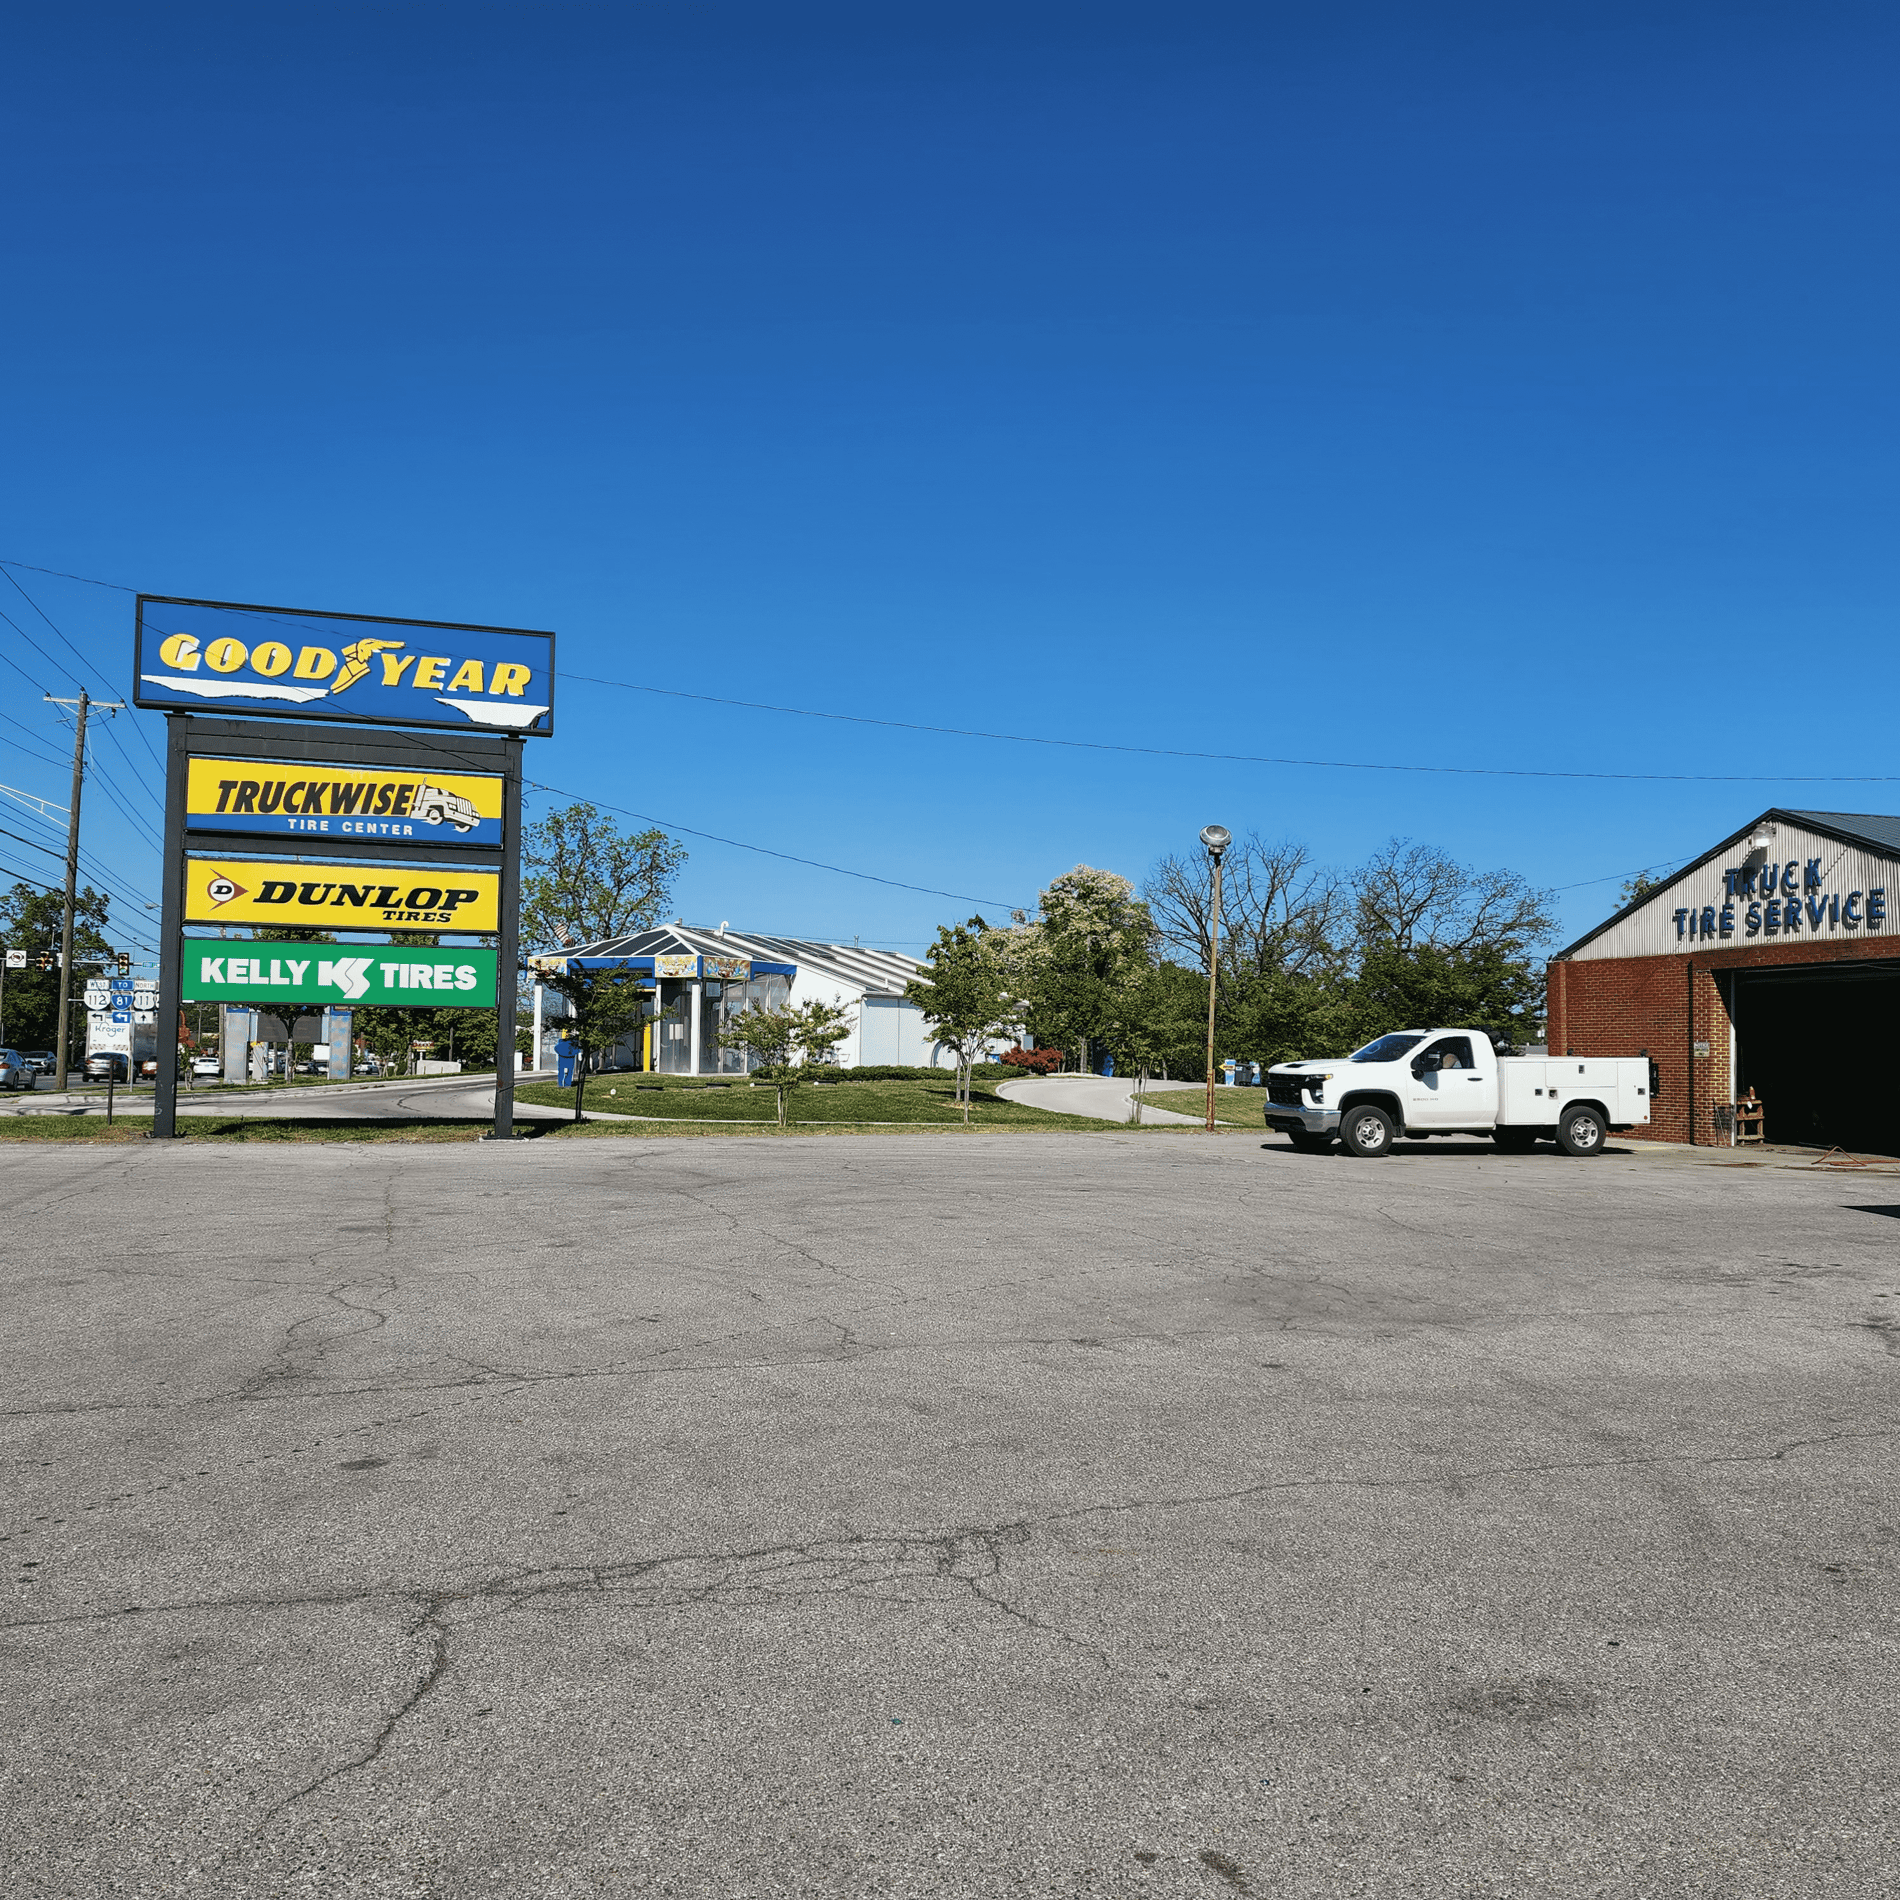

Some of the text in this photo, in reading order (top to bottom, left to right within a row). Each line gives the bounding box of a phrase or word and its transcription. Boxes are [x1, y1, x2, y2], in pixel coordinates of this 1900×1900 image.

[215, 779, 415, 816] TRUCKWISE
[287, 818, 414, 836] TIRE CENTER
[1725, 857, 1822, 896] TRUCK
[213, 880, 480, 911] D DUNLOP
[382, 910, 453, 923] TIRES
[1674, 887, 1887, 936] TIRE SERVICE
[200, 957, 311, 986] KELLY
[379, 962, 477, 991] TIRES
[88, 995, 107, 1005] 112
[116, 996, 128, 1006] 81
[139, 995, 149, 1006] 11
[95, 1022, 126, 1037] Kroger
